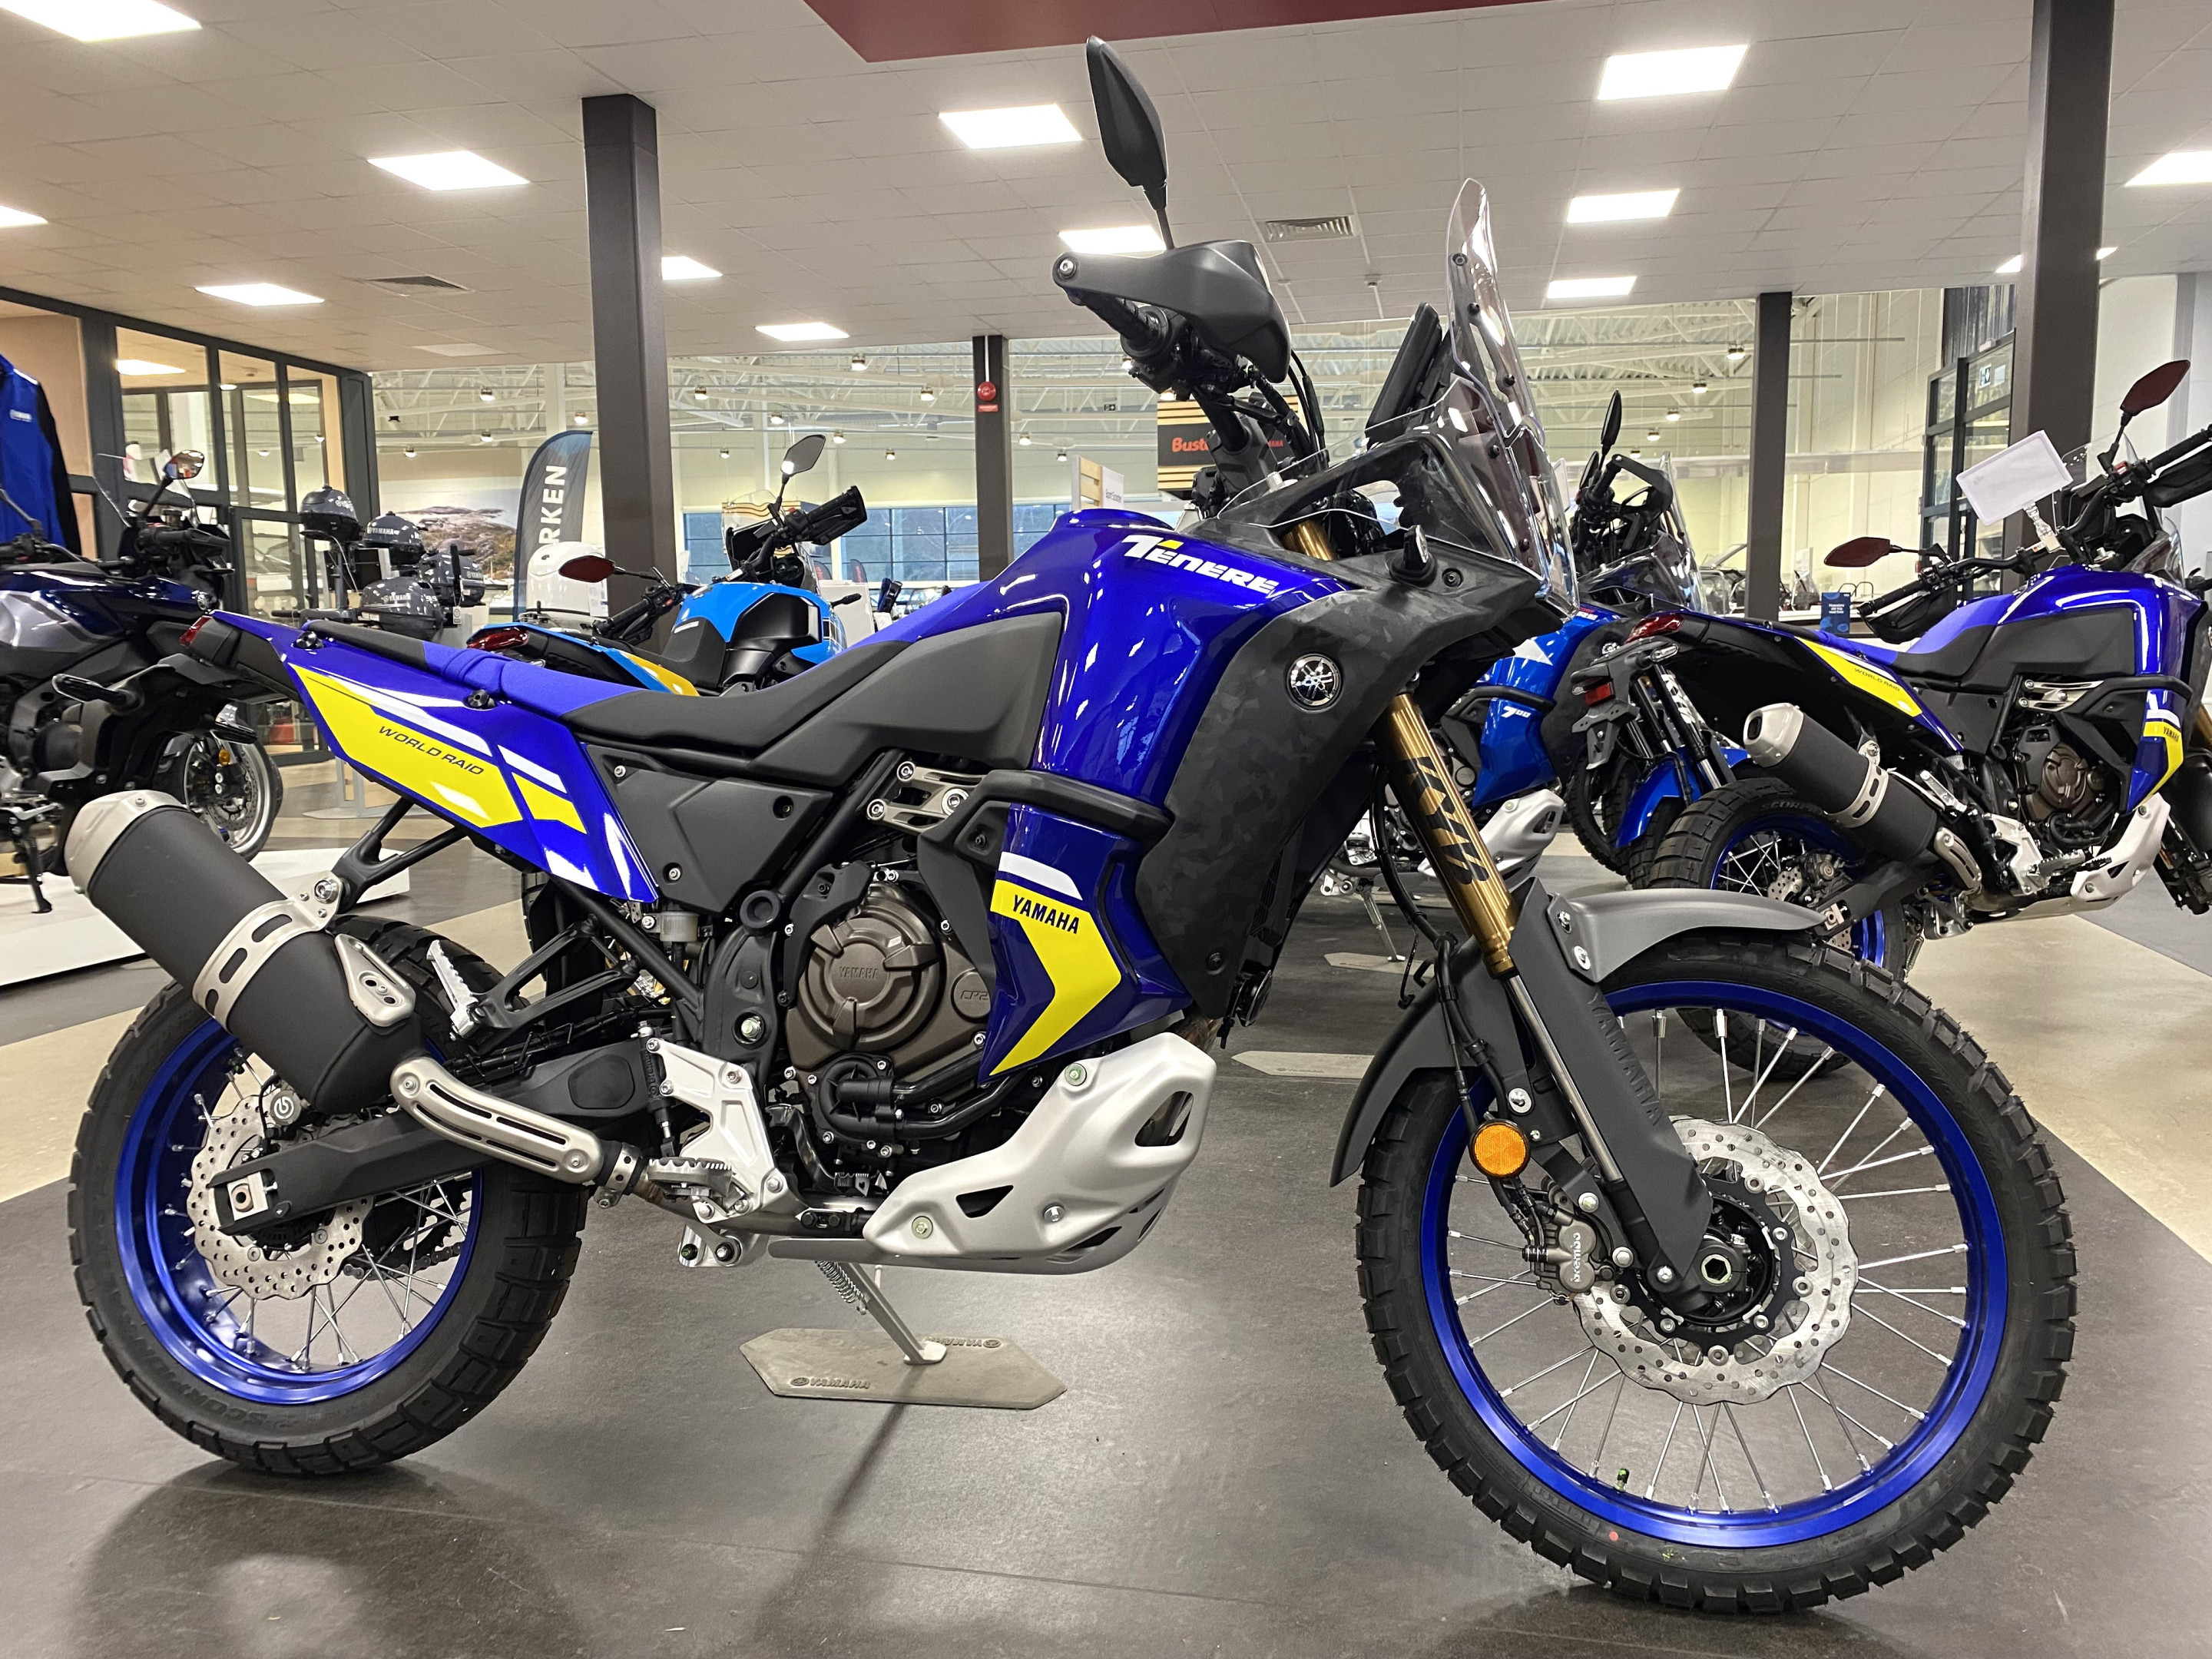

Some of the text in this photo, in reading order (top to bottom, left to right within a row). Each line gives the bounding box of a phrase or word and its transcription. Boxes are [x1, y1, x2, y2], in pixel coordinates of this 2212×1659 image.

[538, 465, 567, 544] RKEN
[1855, 668, 1900, 691] WORLD RAID
[1501, 706, 1531, 718] 700
[379, 726, 484, 774] WORLD RAID
[1013, 894, 1079, 934] YAMAHA
[839, 966, 879, 979] YAMAHA
[961, 990, 988, 1000] CP2
[645, 1050, 656, 1084] bremb
[1588, 992, 1664, 1127] YAMAHA
[1570, 1232, 1581, 1283] brembo
[810, 1378, 871, 1389] YAMAHA
